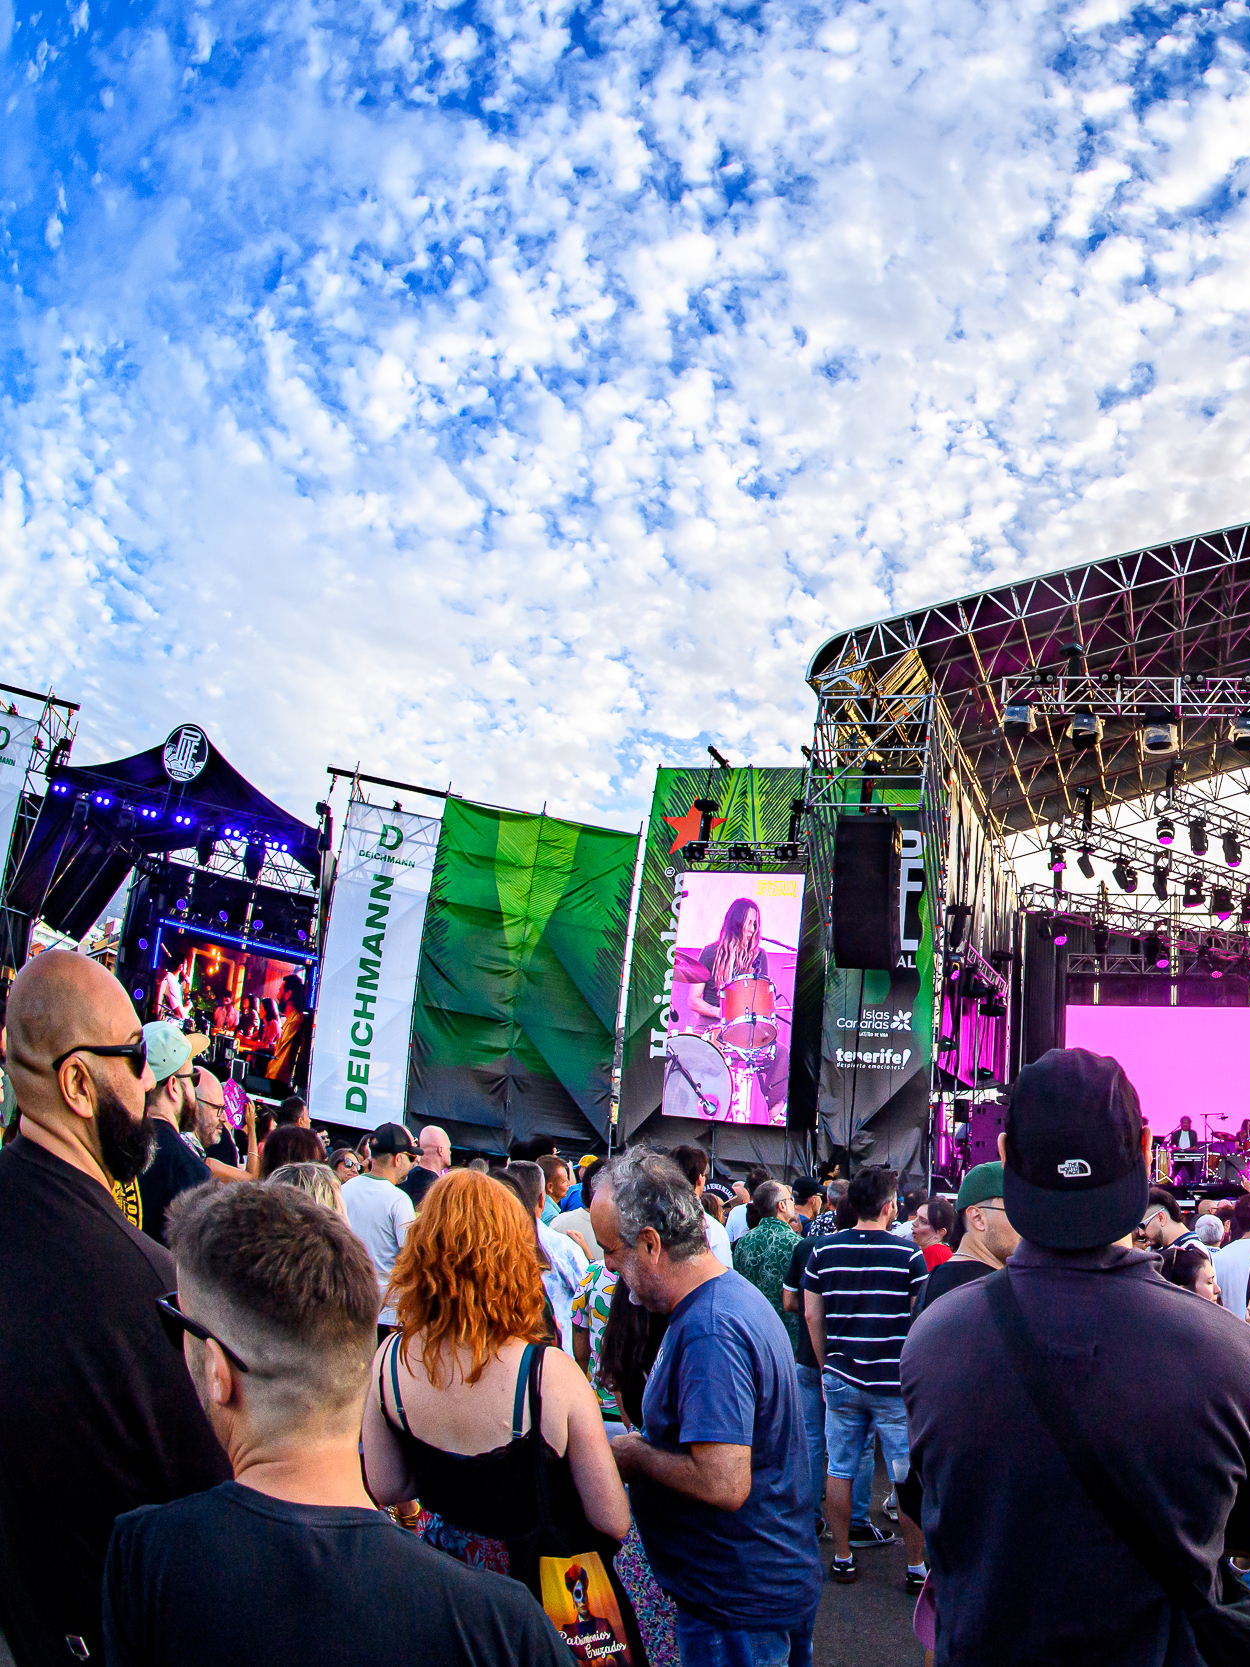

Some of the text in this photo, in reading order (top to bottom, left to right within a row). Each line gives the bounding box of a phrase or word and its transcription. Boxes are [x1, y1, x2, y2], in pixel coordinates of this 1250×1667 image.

[358, 849, 416, 868] DEICHMANN
[345, 873, 394, 1113] DEICHMANN
[836, 1017, 890, 1030] Canarias
[862, 1009, 890, 1021] Islas
[585, 1640, 627, 1660] Cruzados
